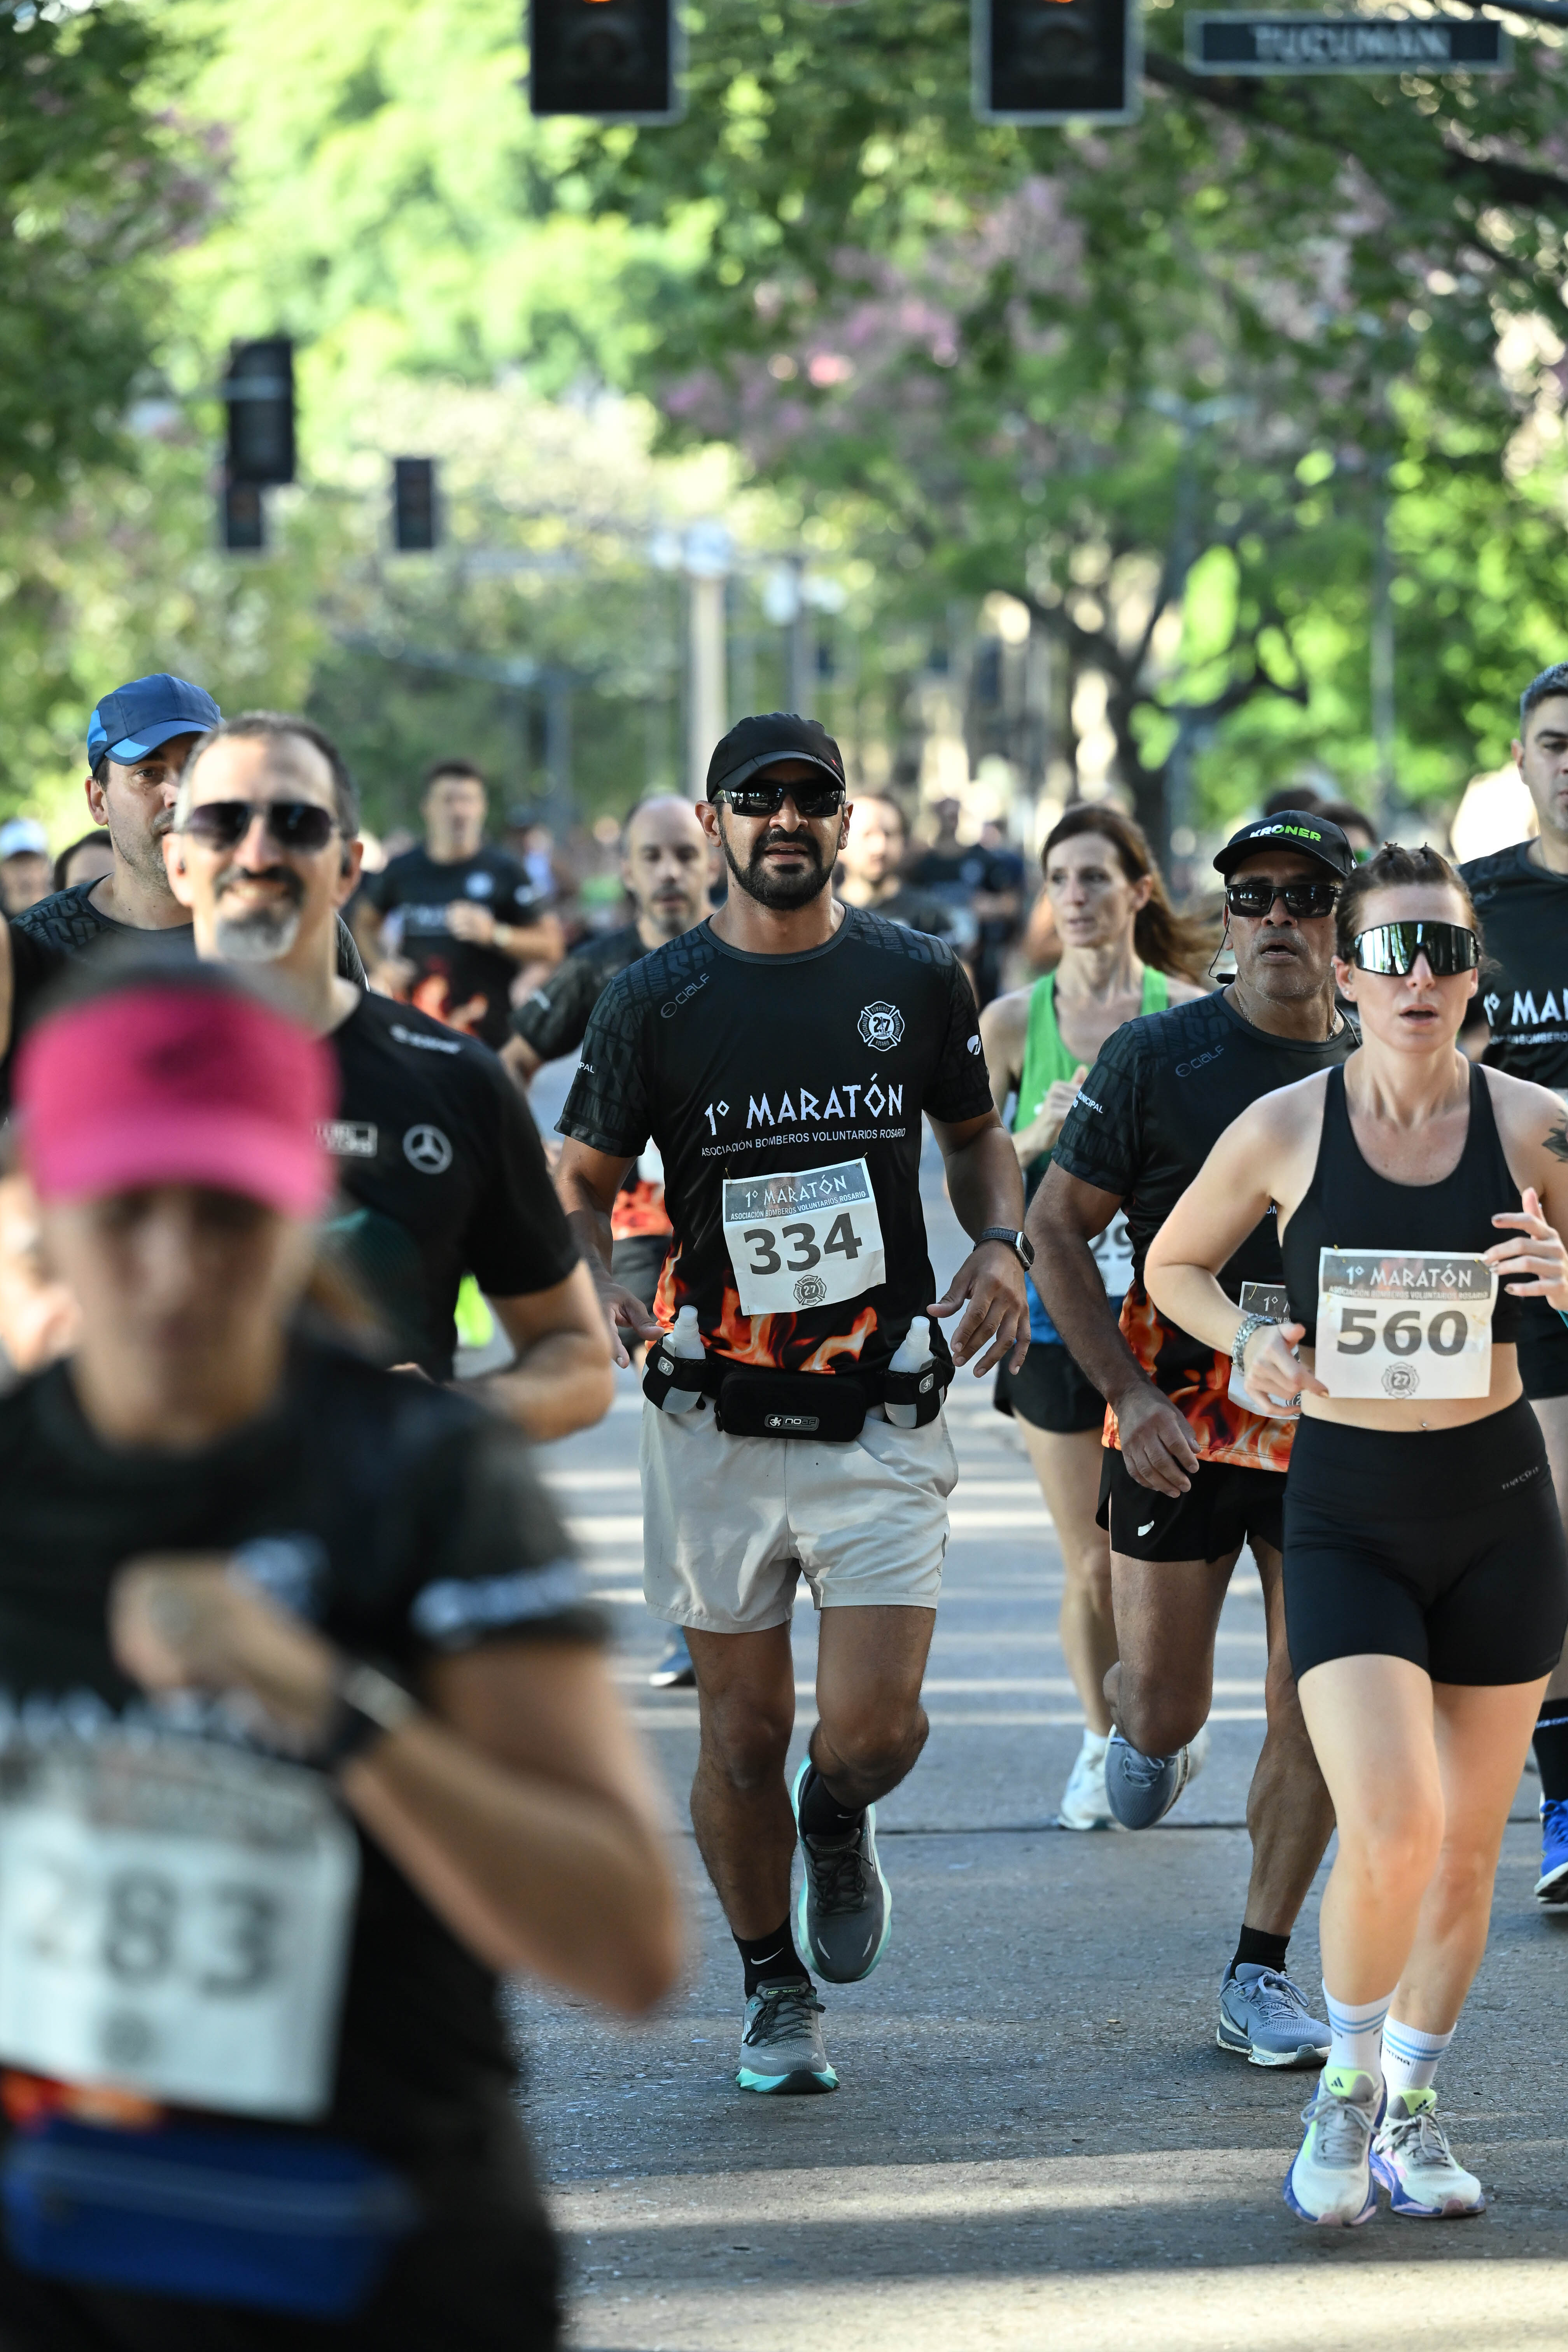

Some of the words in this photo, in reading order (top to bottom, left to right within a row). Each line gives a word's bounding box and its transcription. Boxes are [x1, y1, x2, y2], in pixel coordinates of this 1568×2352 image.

[1250, 824, 1321, 842] KRONER
[873, 1016, 891, 1033] 27
[746, 1073, 903, 1129] MARATÓN
[702, 1140, 752, 1157] ASOCIACIÓN
[756, 1133, 809, 1148] BOMBEROS
[812, 1130, 877, 1142] VOLUNTARIOS
[880, 1128, 905, 1138] ROSARIO
[764, 1174, 847, 1206] MARATÓN
[730, 1209, 764, 1220] ASOCIACIÓN
[765, 1206, 796, 1216] BOMBEROS
[797, 1197, 838, 1211] VOLUNTARIOS
[839, 1191, 866, 1202] ROSARIO
[743, 1212, 863, 1275] 334
[1370, 1263, 1472, 1287] MARATÓN
[803, 1285, 816, 1296] 27
[1337, 1308, 1468, 1356] 560
